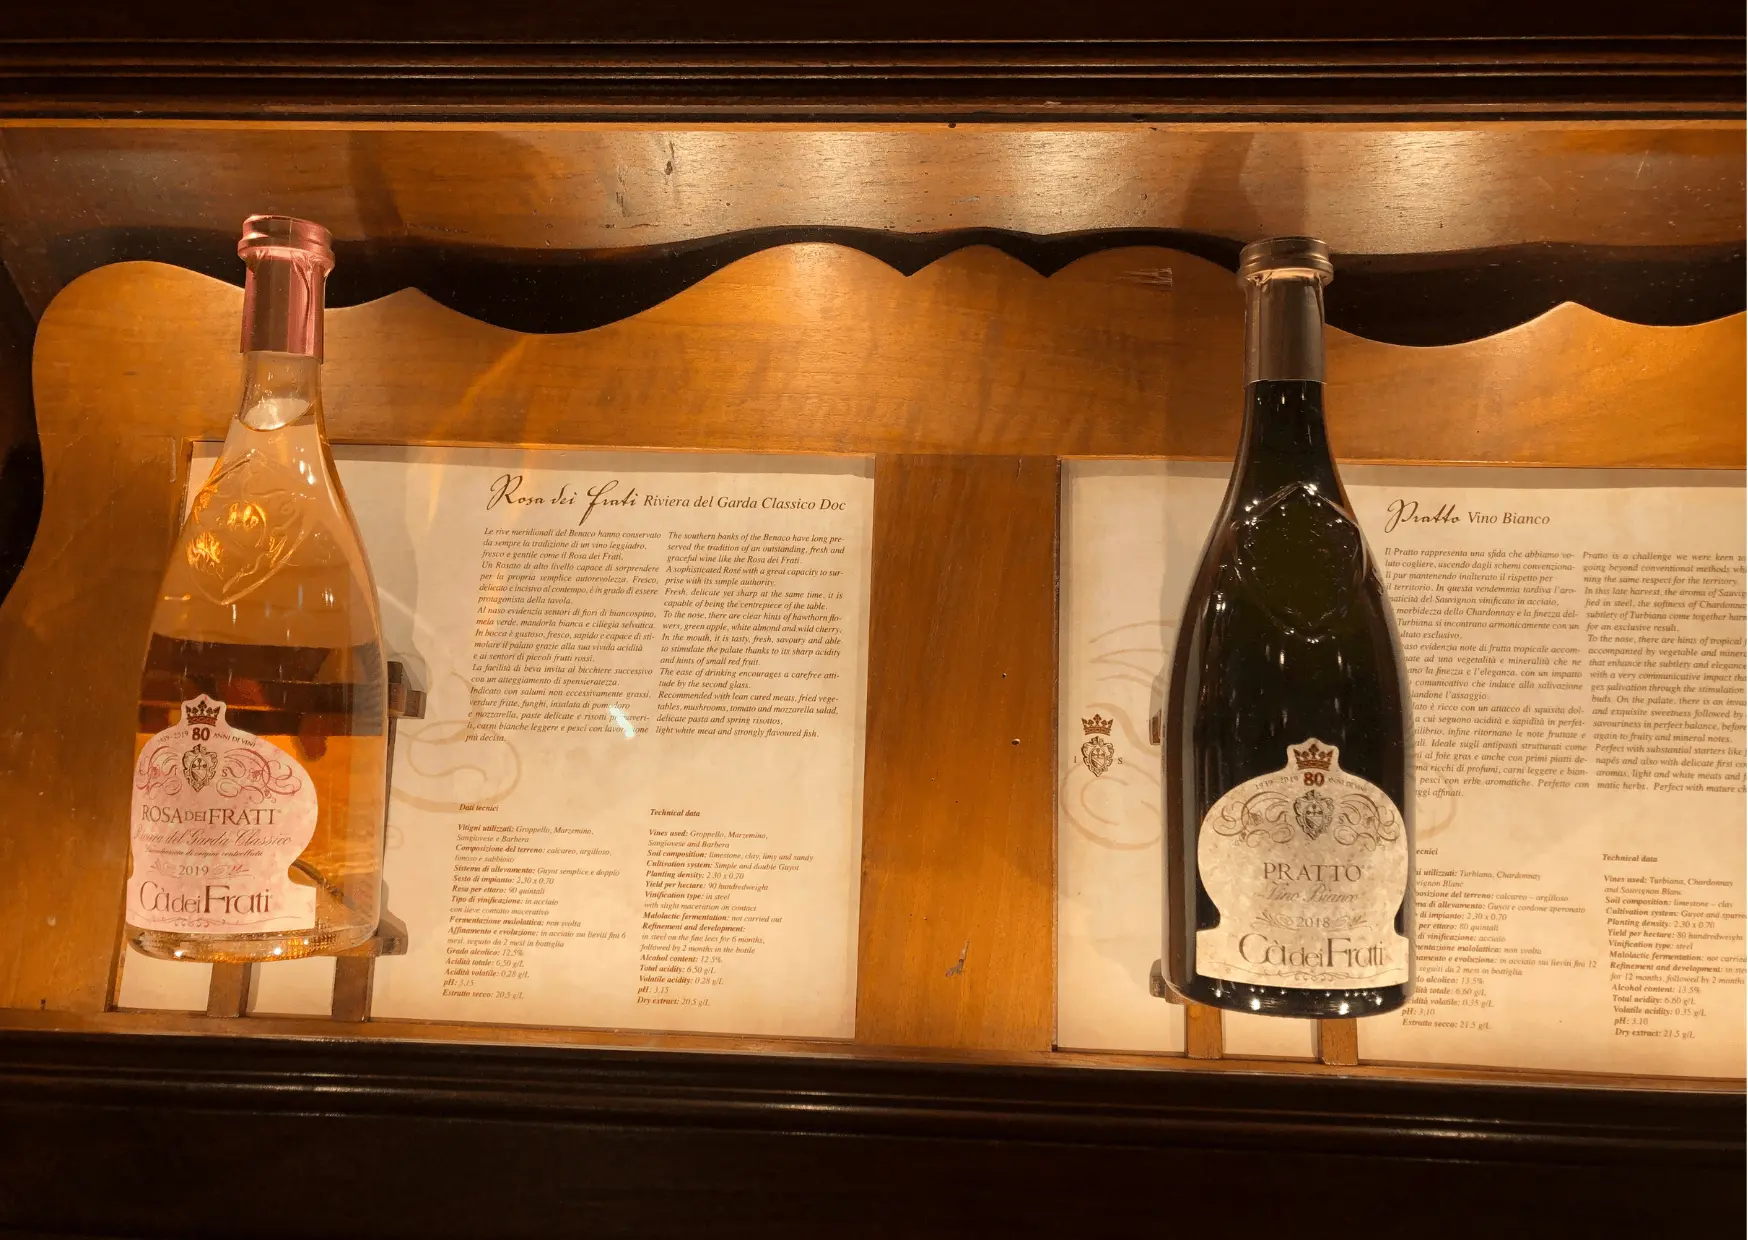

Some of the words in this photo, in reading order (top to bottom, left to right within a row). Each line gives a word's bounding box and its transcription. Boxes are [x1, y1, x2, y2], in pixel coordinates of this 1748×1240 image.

[643, 495, 690, 507] Riviera
[694, 496, 714, 508] del
[718, 497, 757, 508] Garda
[762, 498, 816, 510] Classico
[820, 498, 846, 510] Doc
[1384, 499, 1460, 533] Pratto
[1468, 512, 1498, 524] Vino
[1502, 512, 1550, 525] Bianco
[511, 528, 554, 536] meridionali
[684, 532, 715, 540] southern
[740, 533, 749, 542] of
[750, 533, 762, 541] the
[811, 535, 828, 544] long
[829, 536, 845, 544] pre-
[494, 540, 520, 548] sempre
[609, 541, 647, 551] leggiadro,
[741, 545, 750, 554] of
[762, 545, 808, 555] outstanding,
[809, 546, 828, 555] fresh
[481, 550, 504, 559] fresco
[512, 551, 538, 560] gentile
[667, 555, 698, 564] graceful
[767, 556, 779, 564] dei
[1393, 548, 1418, 556] Pratto
[1421, 549, 1467, 558] rappresenta
[1487, 550, 1506, 559] sfida
[1525, 550, 1559, 558] abbiamo
[495, 561, 521, 569] Rosato
[615, 564, 659, 574] sorprendere
[1586, 622, 1598, 632] for
[1614, 623, 1651, 631] exclusive
[1592, 707, 1608, 715] and
[1611, 708, 1647, 718] exquisite
[1651, 709, 1691, 717] sweetness
[1693, 710, 1730, 720] followed
[1733, 711, 1743, 720] by
[192, 727, 210, 741] 80
[213, 732, 230, 740] ANNI
[656, 726, 673, 736] light
[697, 727, 715, 735] meat
[734, 728, 765, 738] strongly
[766, 729, 801, 739] flavoured
[803, 730, 819, 739] fish.
[1303, 772, 1325, 786] 80
[475, 804, 499, 812] tecnici
[685, 809, 700, 817] data
[142, 805, 183, 823] ROSA
[184, 810, 207, 822] DEI
[209, 809, 277, 825] FRATI
[187, 829, 230, 846] Garda
[231, 830, 292, 847] Classico
[1602, 854, 1639, 862] Technical
[178, 865, 209, 877] 2019
[1263, 862, 1362, 882] PRATTO
[139, 880, 169, 913] Cà
[171, 894, 201, 913] dei
[204, 885, 270, 913] Frati
[452, 885, 469, 893] Resa
[470, 887, 482, 895] per
[519, 887, 545, 896] quintali
[642, 922, 682, 932] Refinement
[684, 923, 697, 931] and
[699, 924, 746, 934] development:
[1296, 917, 1331, 928] 2018
[1470, 924, 1498, 933] quintali
[1239, 933, 1286, 965] Cà
[1290, 948, 1323, 967] dei
[1327, 938, 1384, 968] Frati
